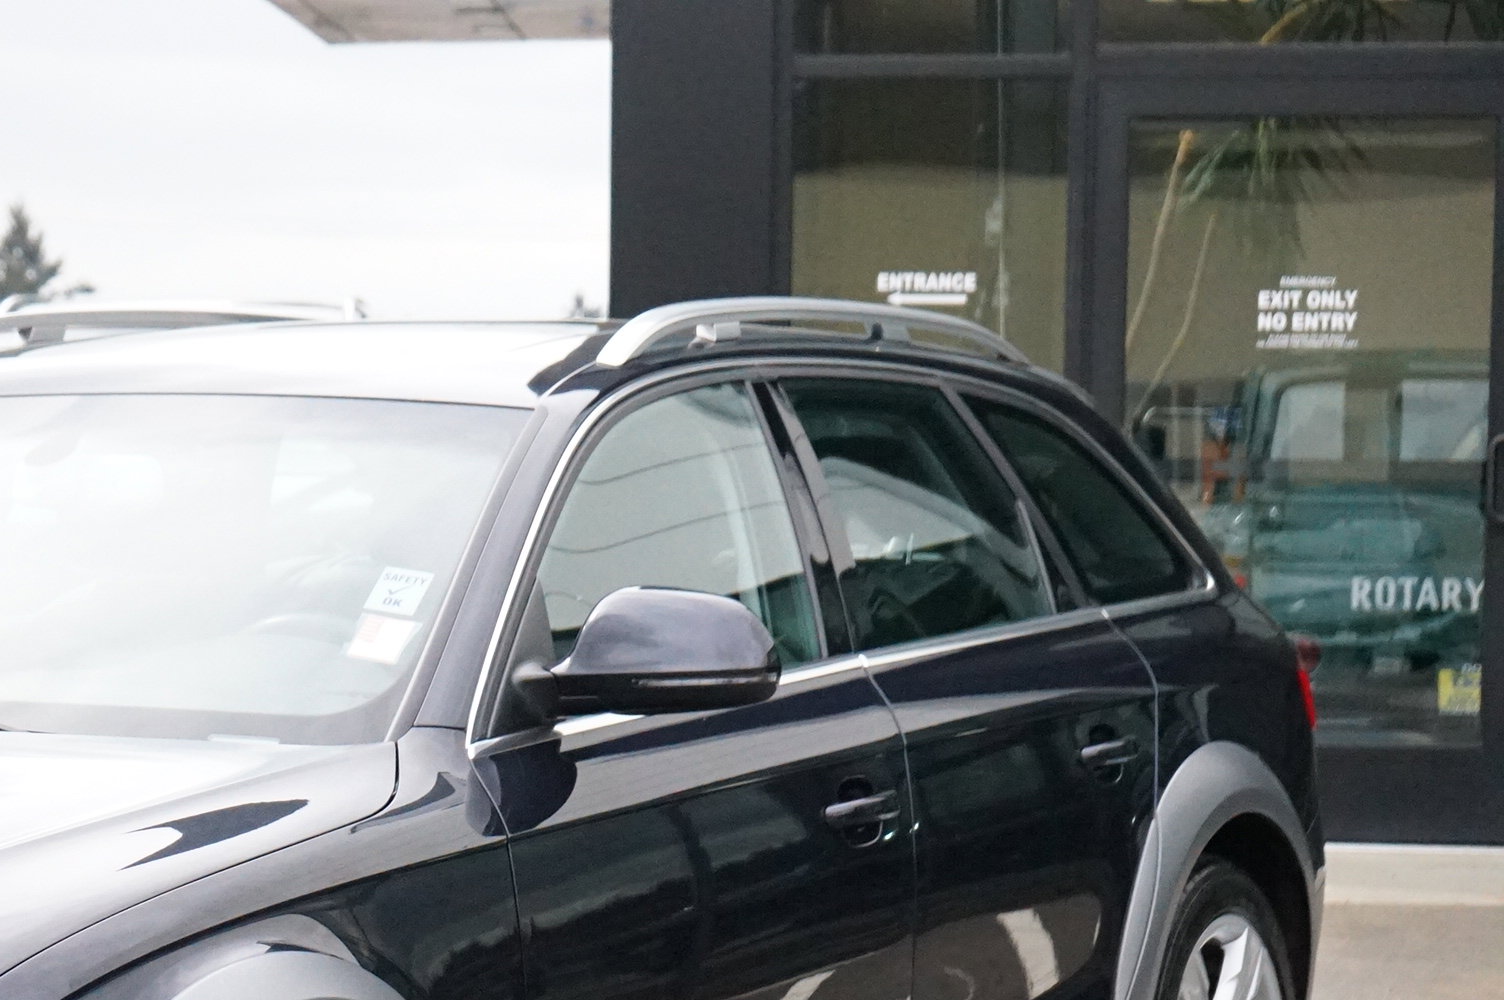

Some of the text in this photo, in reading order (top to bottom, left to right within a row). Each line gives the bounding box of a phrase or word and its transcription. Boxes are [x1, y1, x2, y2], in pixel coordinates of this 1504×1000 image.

[877, 271, 976, 293] ENTRANCE
[1257, 289, 1358, 310] EXIT ONLY
[1257, 311, 1358, 332] NO ENTRY
[383, 573, 427, 585] SAFETY
[382, 597, 402, 607] OK
[1350, 575, 1485, 613] ROTARY
